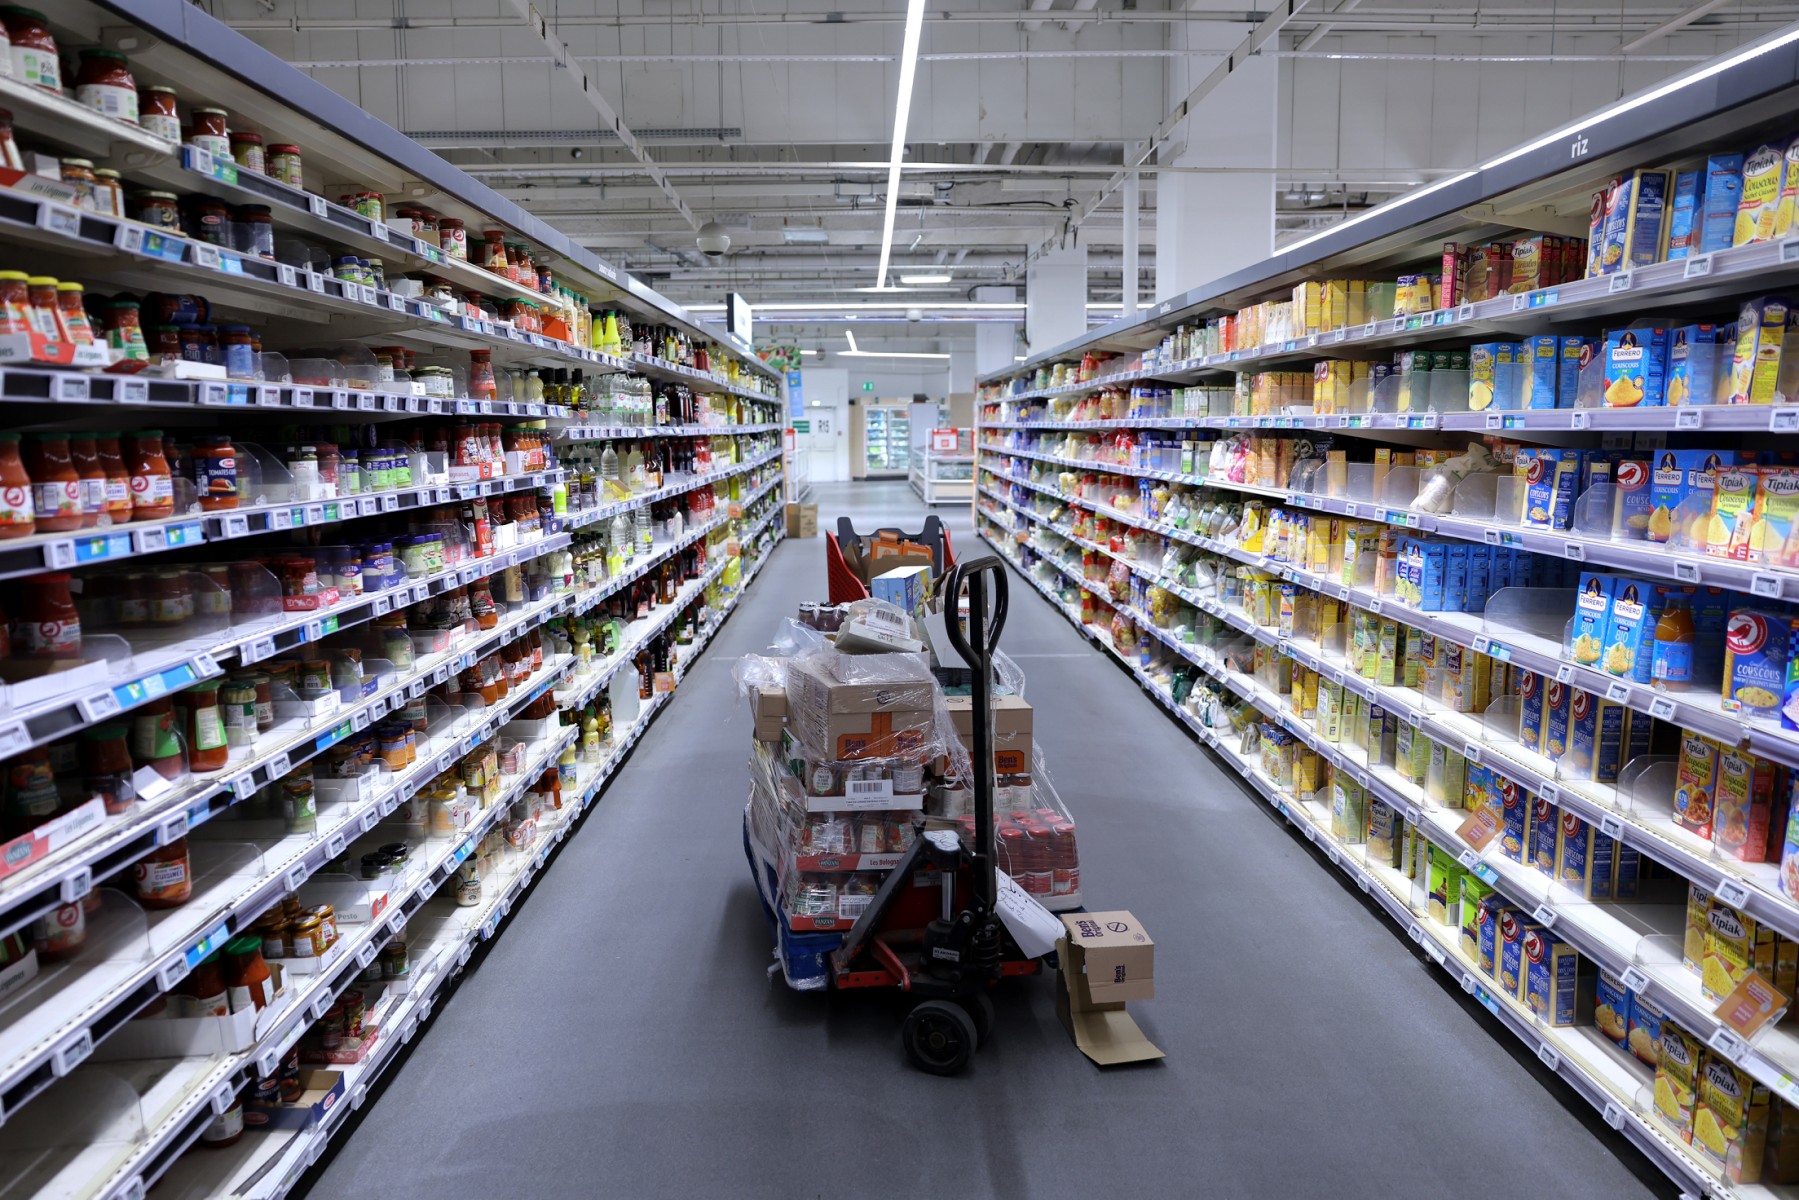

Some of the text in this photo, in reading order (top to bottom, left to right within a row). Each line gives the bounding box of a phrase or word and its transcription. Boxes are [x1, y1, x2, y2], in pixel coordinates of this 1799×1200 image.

[1571, 134, 1589, 159] riz
[1747, 153, 1775, 176] Tipiak
[1744, 176, 1779, 193] Couscous
[1514, 246, 1533, 256] Tipiak
[1656, 472, 1680, 480] FERRERO
[1698, 474, 1716, 484] FERRE
[1721, 476, 1744, 490] Tipiak
[1768, 478, 1799, 492] Tipiak
[1530, 489, 1550, 500] COUSCOUS
[1626, 496, 1650, 505] COUSC
[1719, 494, 1746, 504] Couscous
[1580, 594, 1605, 608] FERRERO
[1580, 609, 1602, 618] COUSCOUS
[1616, 602, 1641, 616] FERRERO
[1581, 622, 1594, 634] BIO
[1614, 617, 1637, 628] COUSCOUS
[1615, 631, 1628, 642] BIO
[1737, 664, 1780, 680] COUSCOUS
[1549, 720, 1566, 732] COUSCOUS
[846, 739, 866, 747] Ben's
[1685, 740, 1707, 757] Tipiak
[998, 756, 1018, 764] Ben's
[1685, 755, 1711, 772] Couscous
[1724, 756, 1744, 774] Tipiak
[1690, 766, 1708, 778] Sauce
[1722, 772, 1747, 790] Couscous
[1728, 784, 1745, 798] Sauce
[879, 859, 902, 867] Bologna
[1692, 887, 1707, 904] Tipi
[1075, 920, 1095, 938] Ben's
[1710, 914, 1741, 937] Tipiak
[1503, 950, 1518, 968] COUSCOUS
[1529, 971, 1548, 991] COUSCOUS
[1601, 969, 1625, 990] FERRERO
[1600, 982, 1624, 1002] COUSCOUS
[1634, 1004, 1660, 1026] COUSCOUS
[1663, 1038, 1687, 1063] Tipiak
[1708, 1066, 1736, 1096] Tipiak
